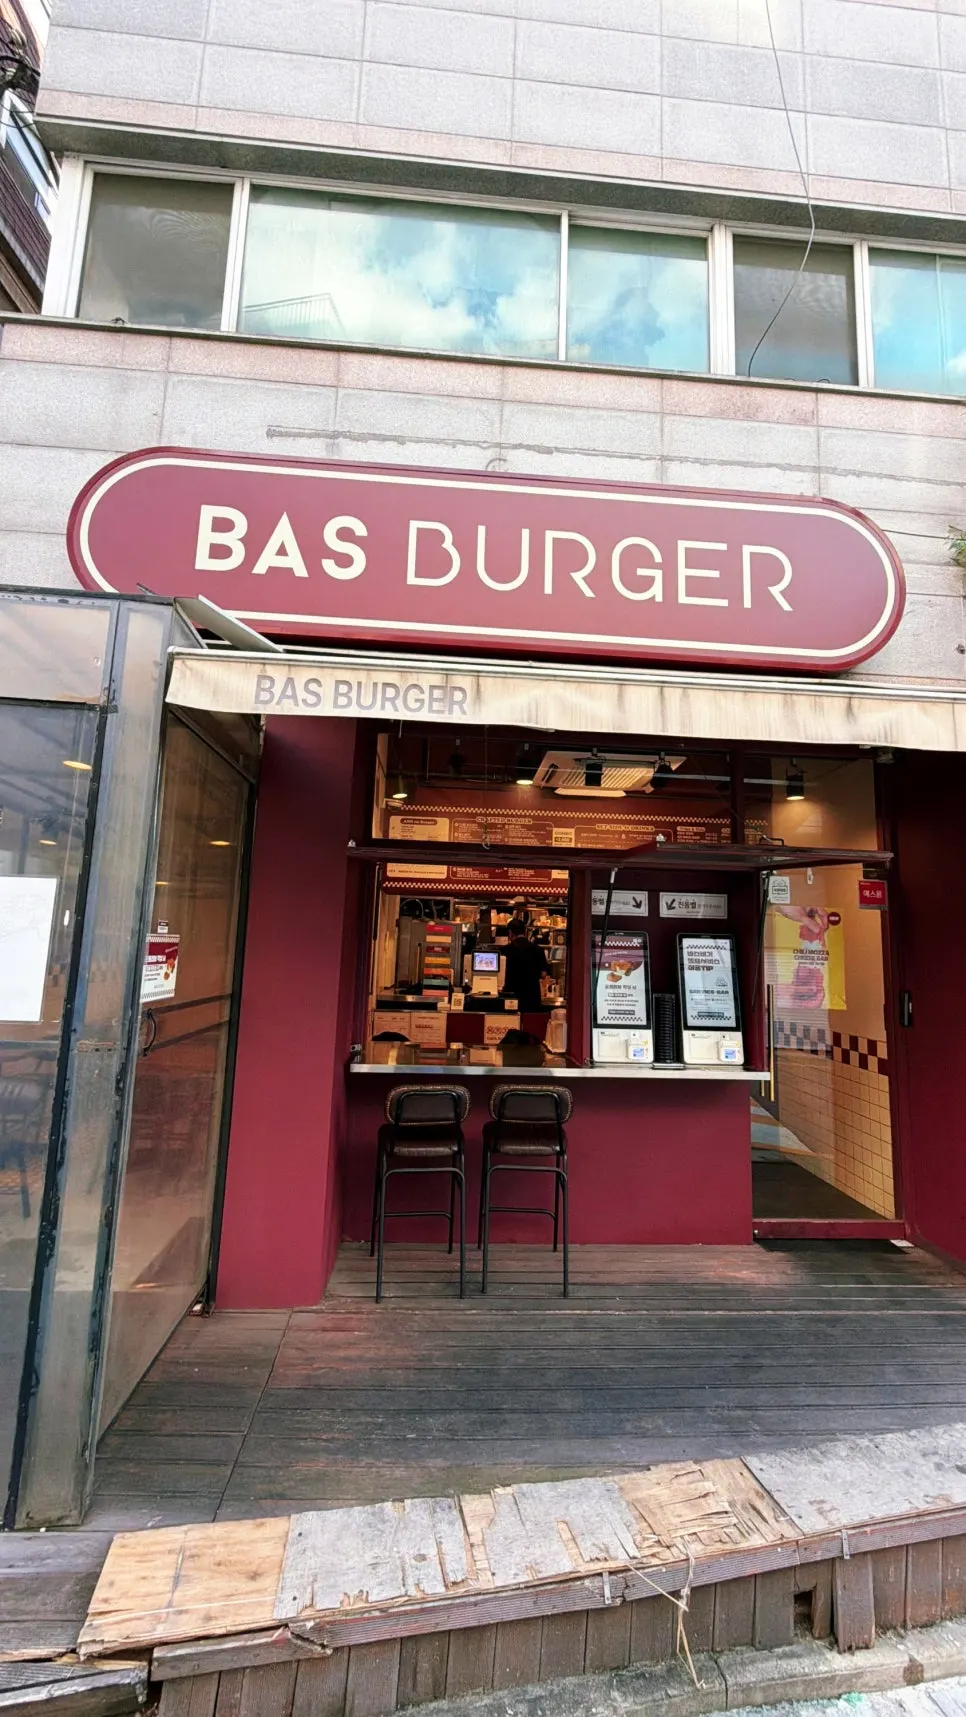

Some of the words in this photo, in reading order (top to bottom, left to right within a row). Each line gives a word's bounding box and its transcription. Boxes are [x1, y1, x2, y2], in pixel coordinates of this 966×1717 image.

[194, 503, 369, 580] BAS
[405, 519, 794, 613] BURGER
[254, 674, 323, 708] BAS
[332, 679, 469, 718] BURGER
[591, 895, 605, 906] 동벨
